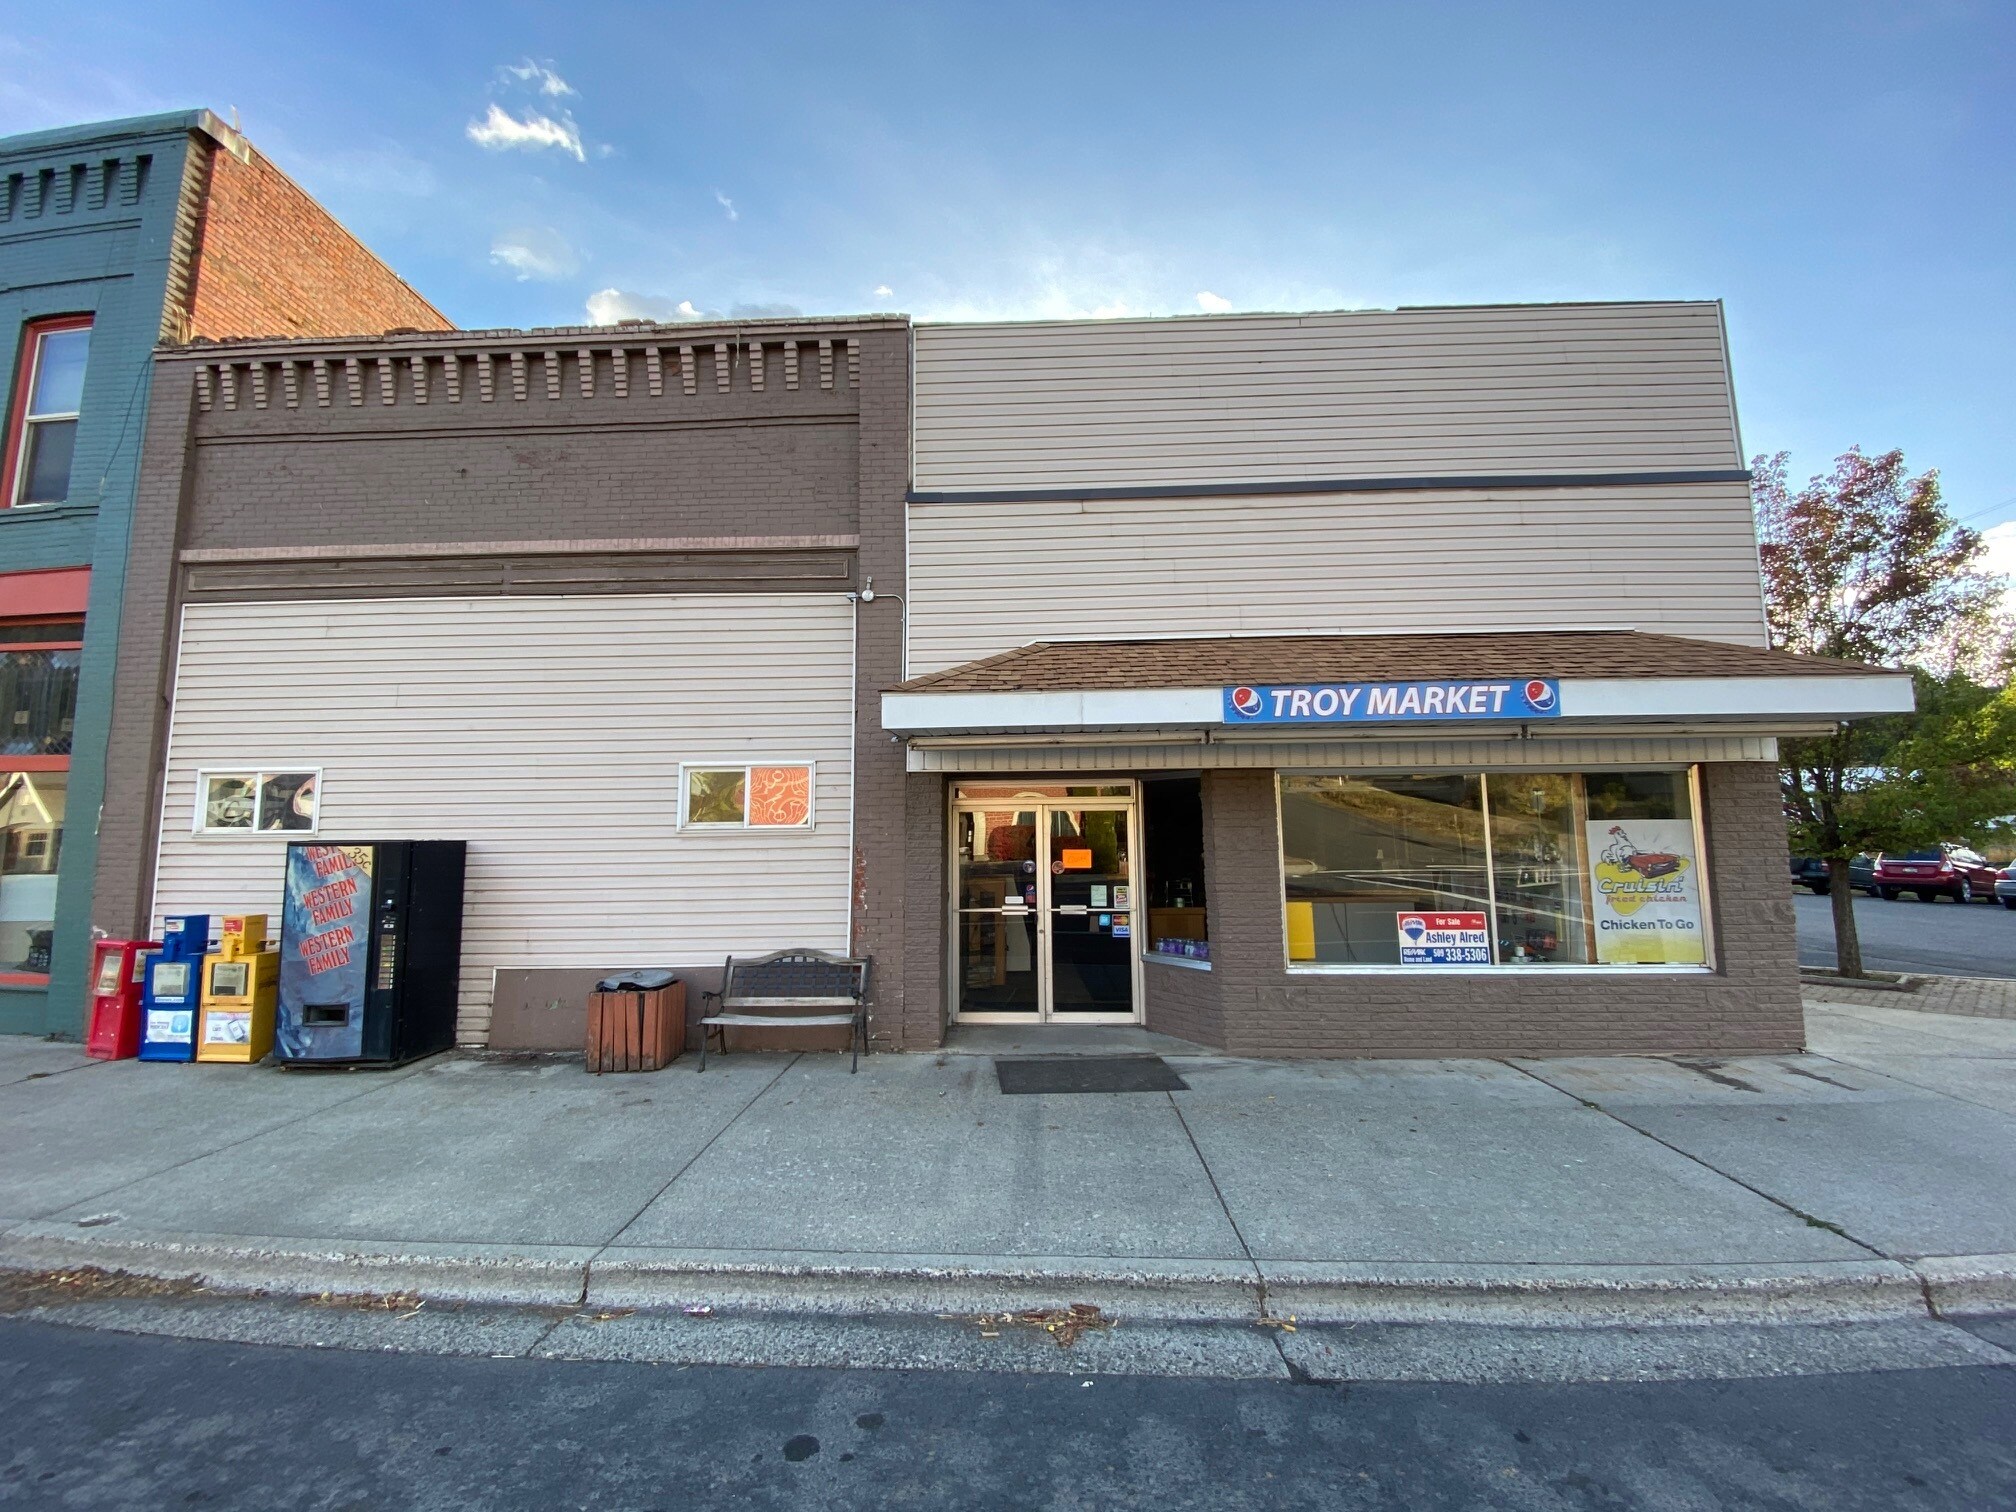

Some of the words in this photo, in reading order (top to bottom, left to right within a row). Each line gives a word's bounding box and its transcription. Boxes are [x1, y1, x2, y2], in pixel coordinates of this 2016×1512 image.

[1270, 688, 1363, 717] TROY
[1366, 685, 1510, 715] MARKET
[303, 878, 357, 909] WESTERN
[1640, 895, 1687, 903] chicken
[312, 899, 354, 926] FAMILY
[1436, 918, 1445, 926] For
[1447, 918, 1461, 926] Sale
[1601, 920, 1656, 930] Chicken
[1657, 919, 1673, 929] To
[1675, 919, 1695, 929] Go
[300, 926, 354, 957] WESTERN
[1426, 932, 1457, 946] Ashley
[1460, 932, 1485, 943] Alred
[309, 948, 351, 975] FAMILY
[1433, 948, 1445, 957] 509
[1445, 948, 1487, 962] 338-5306
